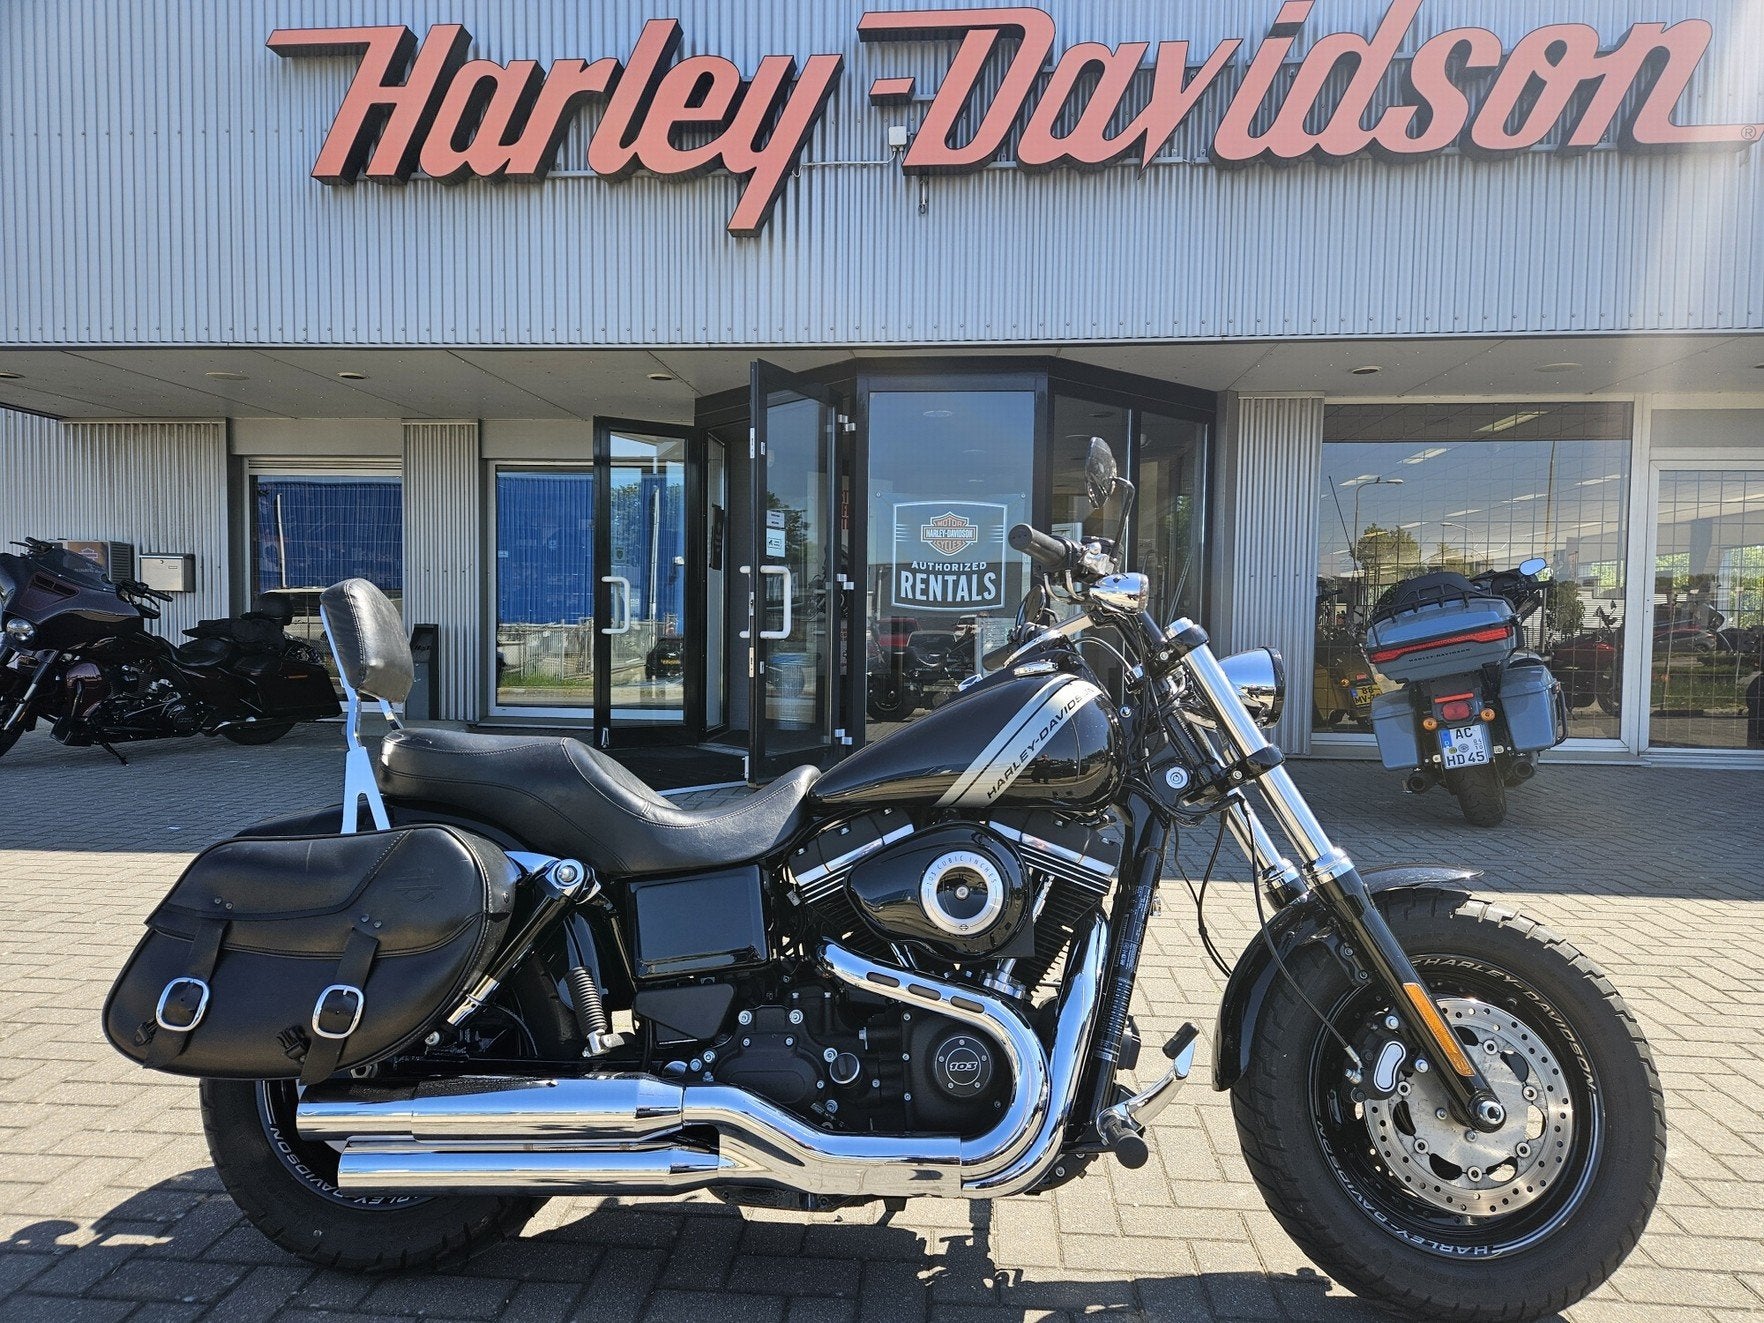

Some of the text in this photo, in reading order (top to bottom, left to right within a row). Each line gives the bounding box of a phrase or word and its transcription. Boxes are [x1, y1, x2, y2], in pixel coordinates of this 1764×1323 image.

[937, 518, 962, 527] MOTOR
[926, 529, 974, 538] HARLEY-DAVIDSON
[937, 541, 962, 551] CYCLES
[911, 560, 987, 572] AUTHORIZED
[900, 570, 997, 602] RENTALS
[1408, 649, 1470, 662] HARLEY-DAVIDSON
[1455, 727, 1473, 739] AC
[1447, 751, 1485, 766] HD 45
[937, 855, 963, 870] CUBIC
[969, 857, 997, 884] INCHES
[1425, 957, 1597, 1091] HARLEY-DAVIDSON
[950, 1062, 978, 1071] 103
